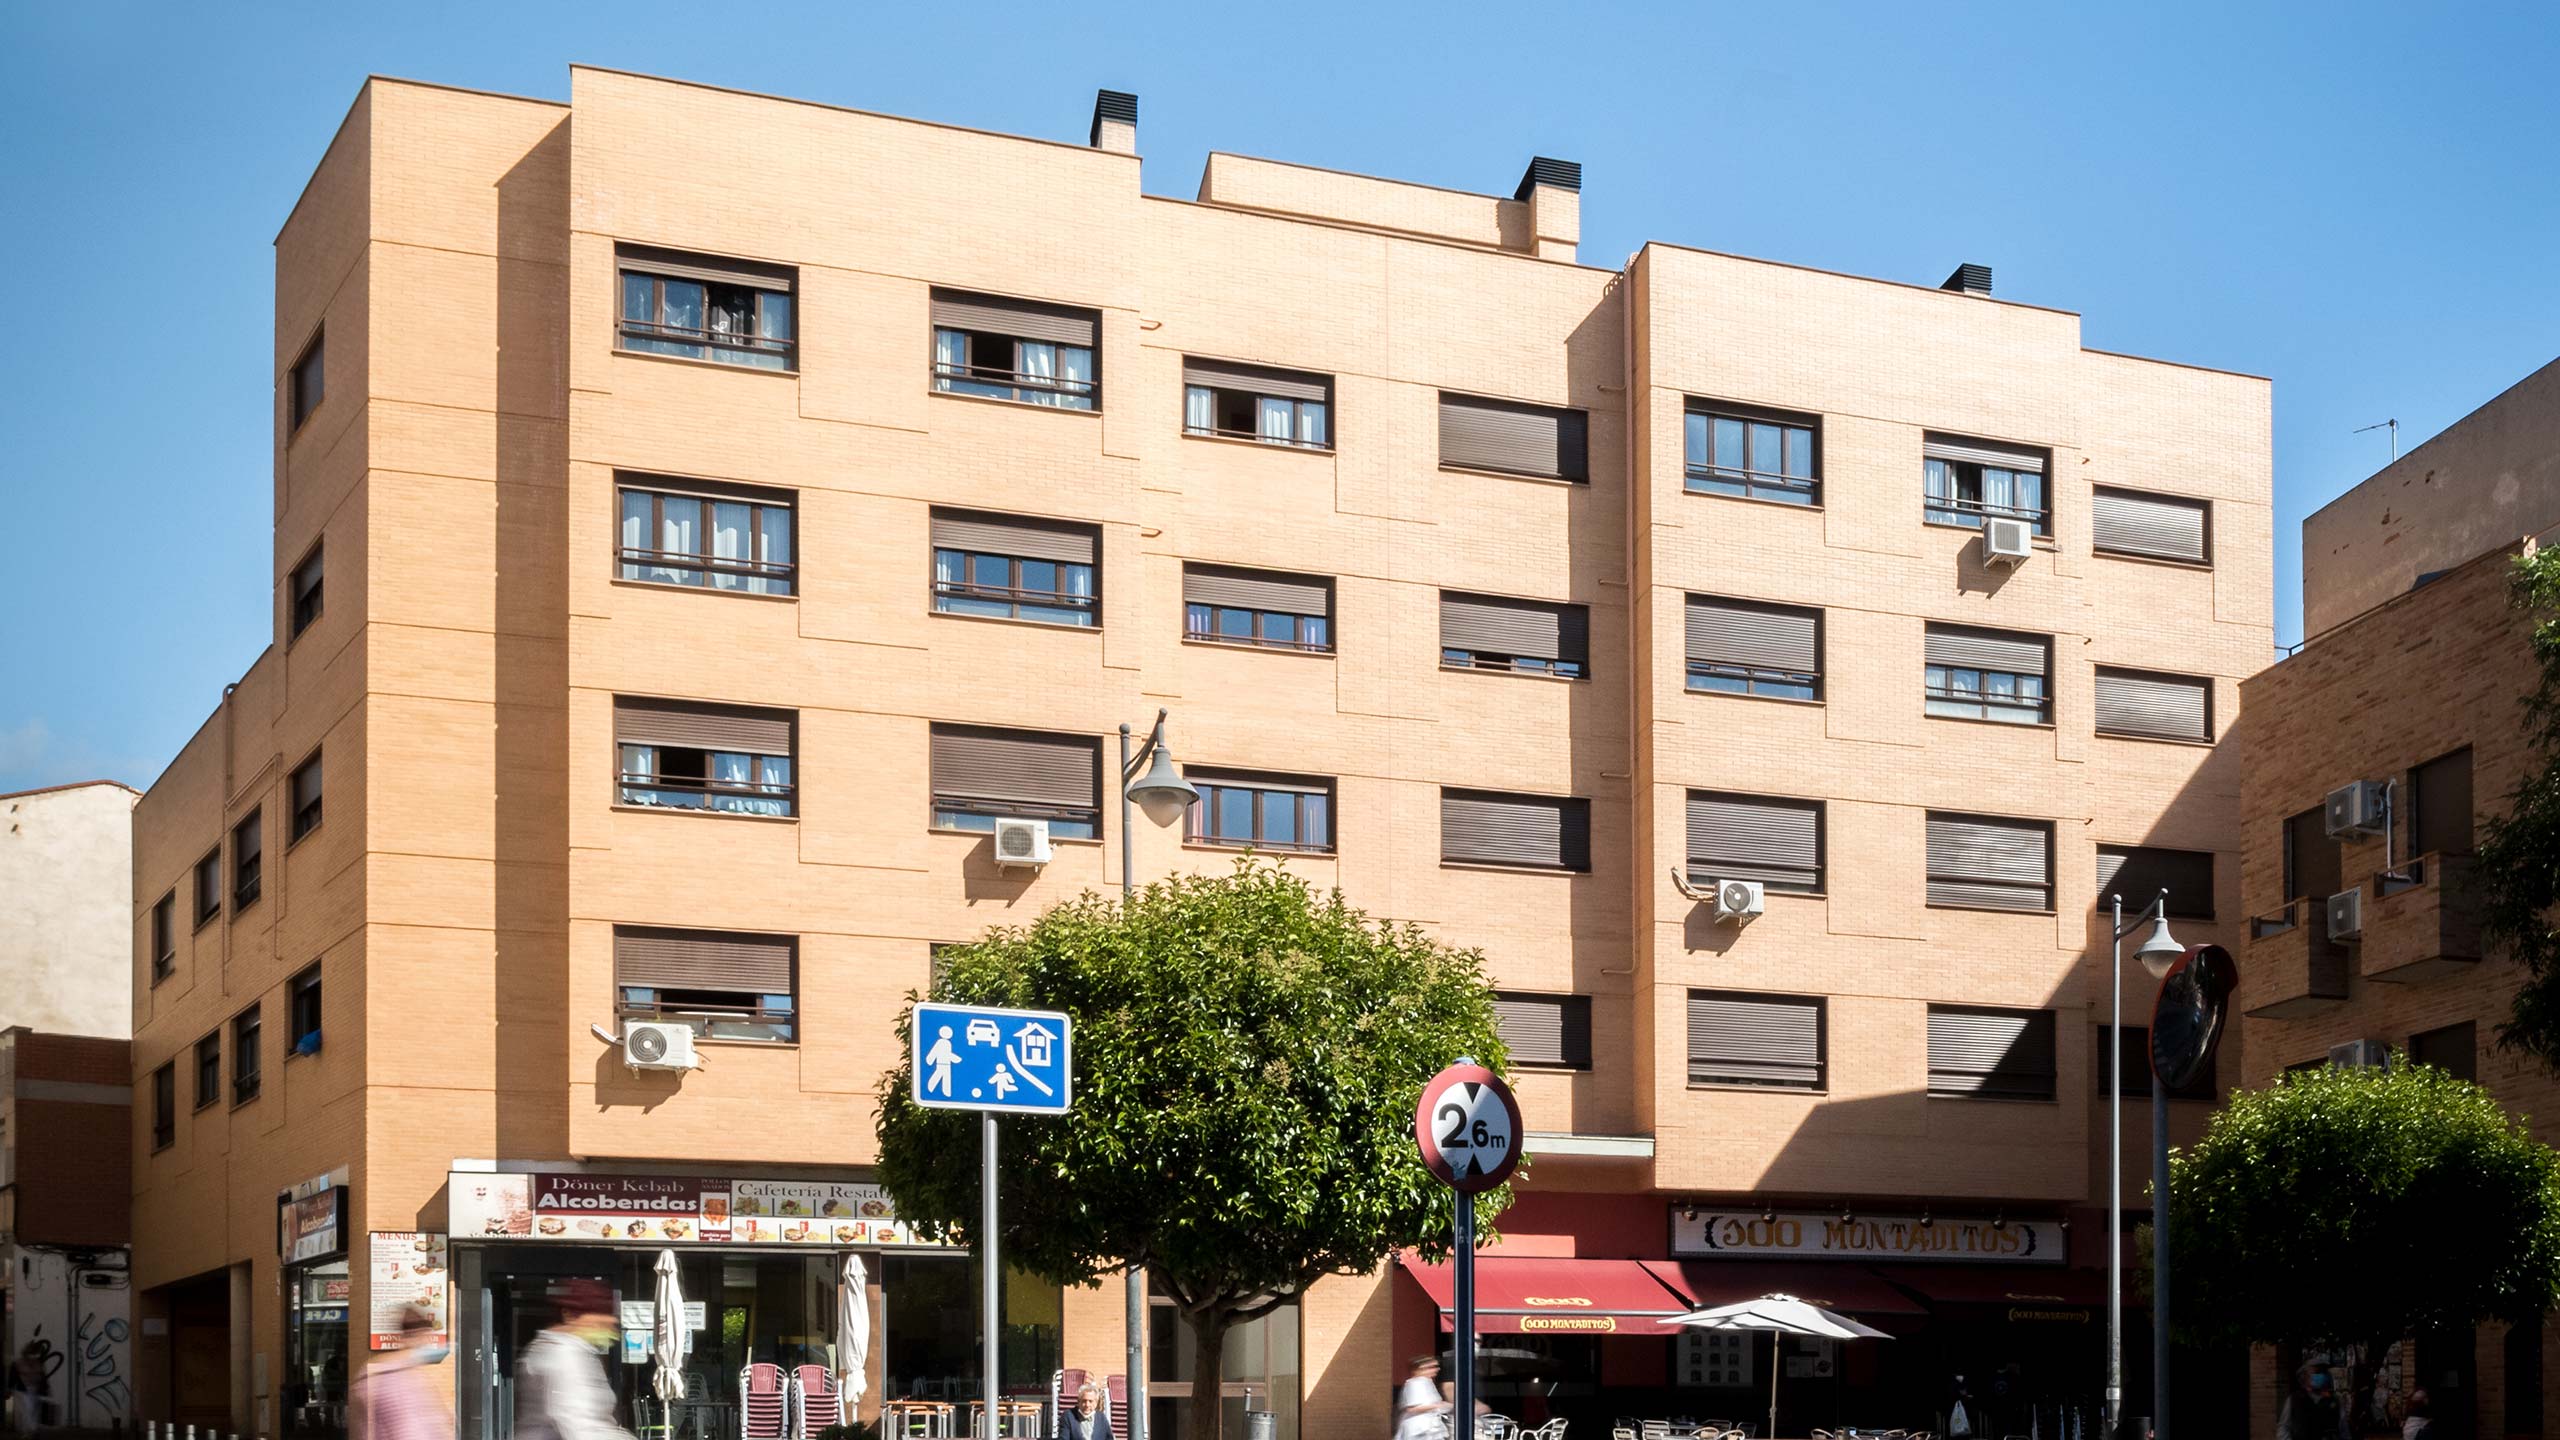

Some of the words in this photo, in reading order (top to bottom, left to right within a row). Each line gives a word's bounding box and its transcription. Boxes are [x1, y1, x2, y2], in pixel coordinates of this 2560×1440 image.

[552, 1178, 615, 1191] Döner
[623, 1180, 684, 1193] Kebab
[738, 1183, 822, 1197] Cafetería
[538, 1193, 697, 1211] Alcobendas
[1823, 1220, 2020, 1254] MONTADITOS
[1550, 1319, 1611, 1329] MONTADITOS
